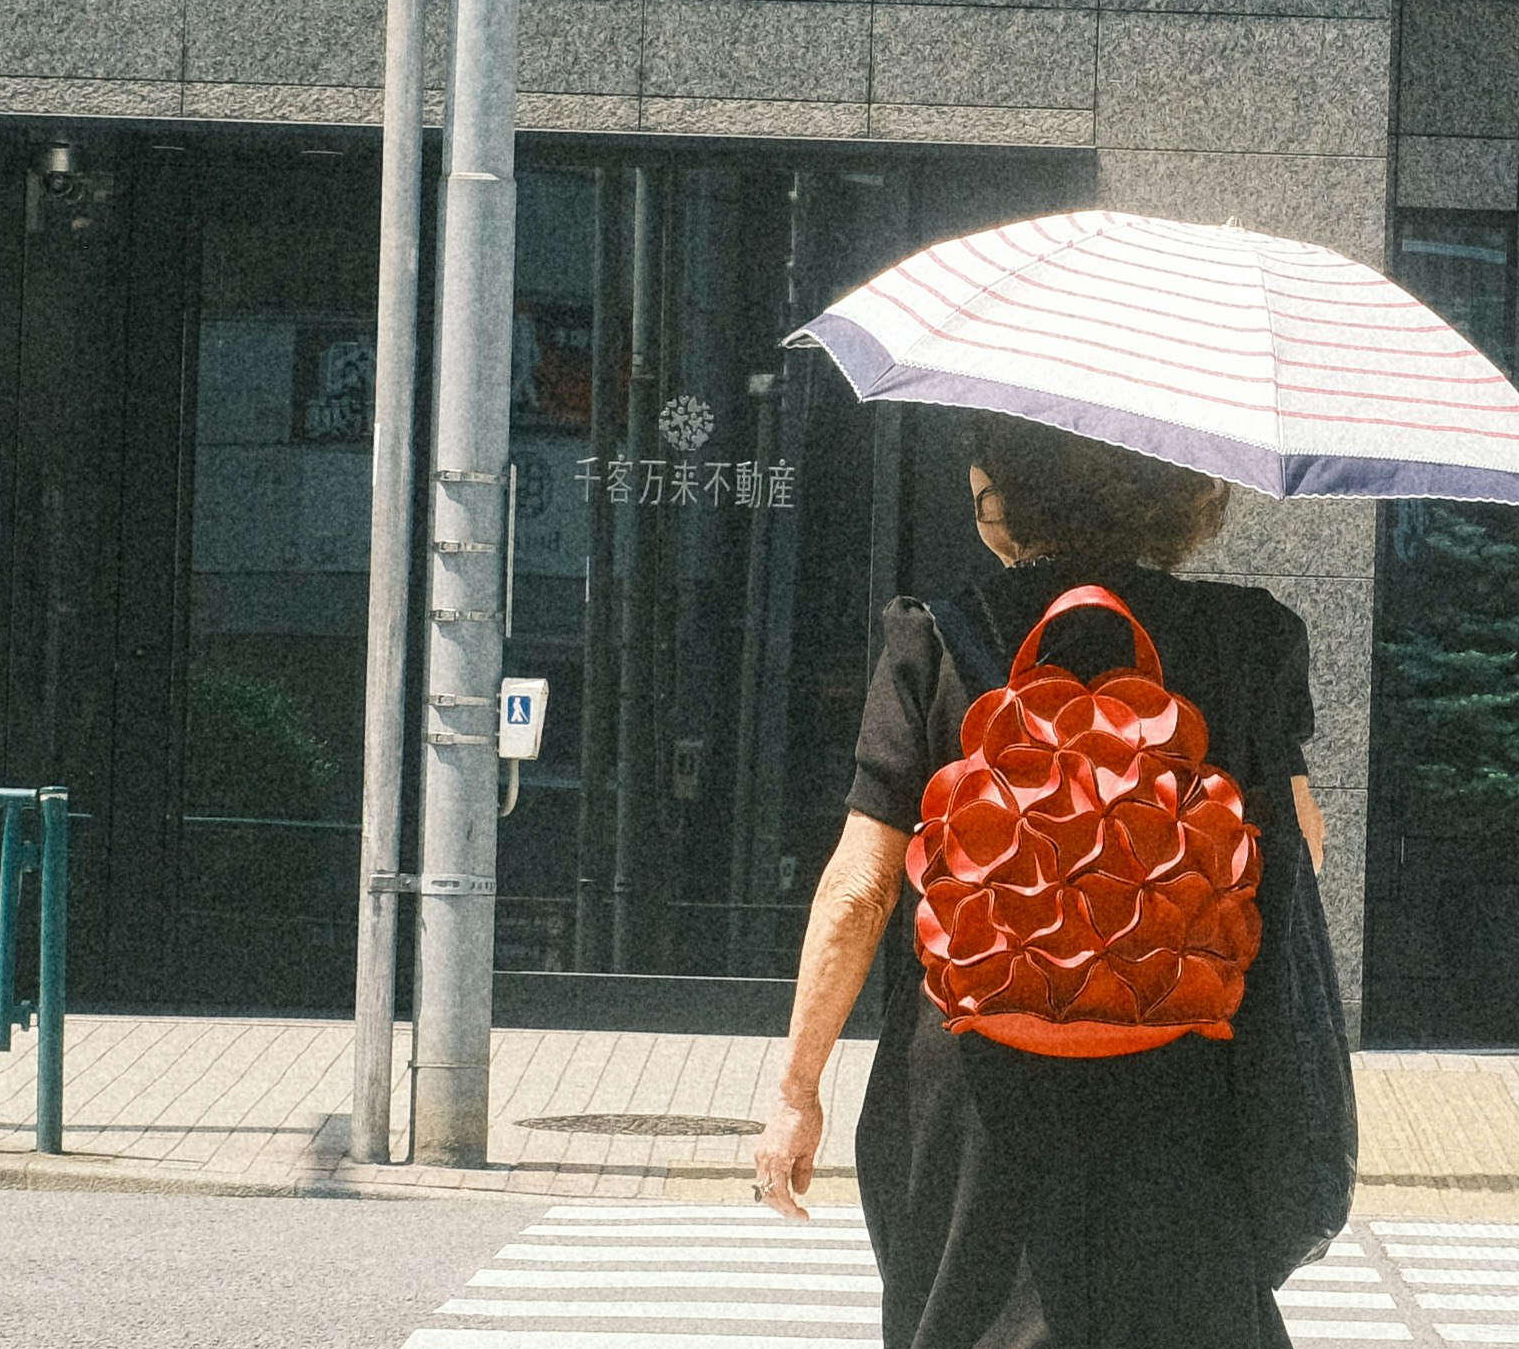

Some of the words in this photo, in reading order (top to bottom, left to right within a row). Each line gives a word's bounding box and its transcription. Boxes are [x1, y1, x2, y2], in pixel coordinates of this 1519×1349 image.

[573, 454, 795, 509] 千客万来不動産
